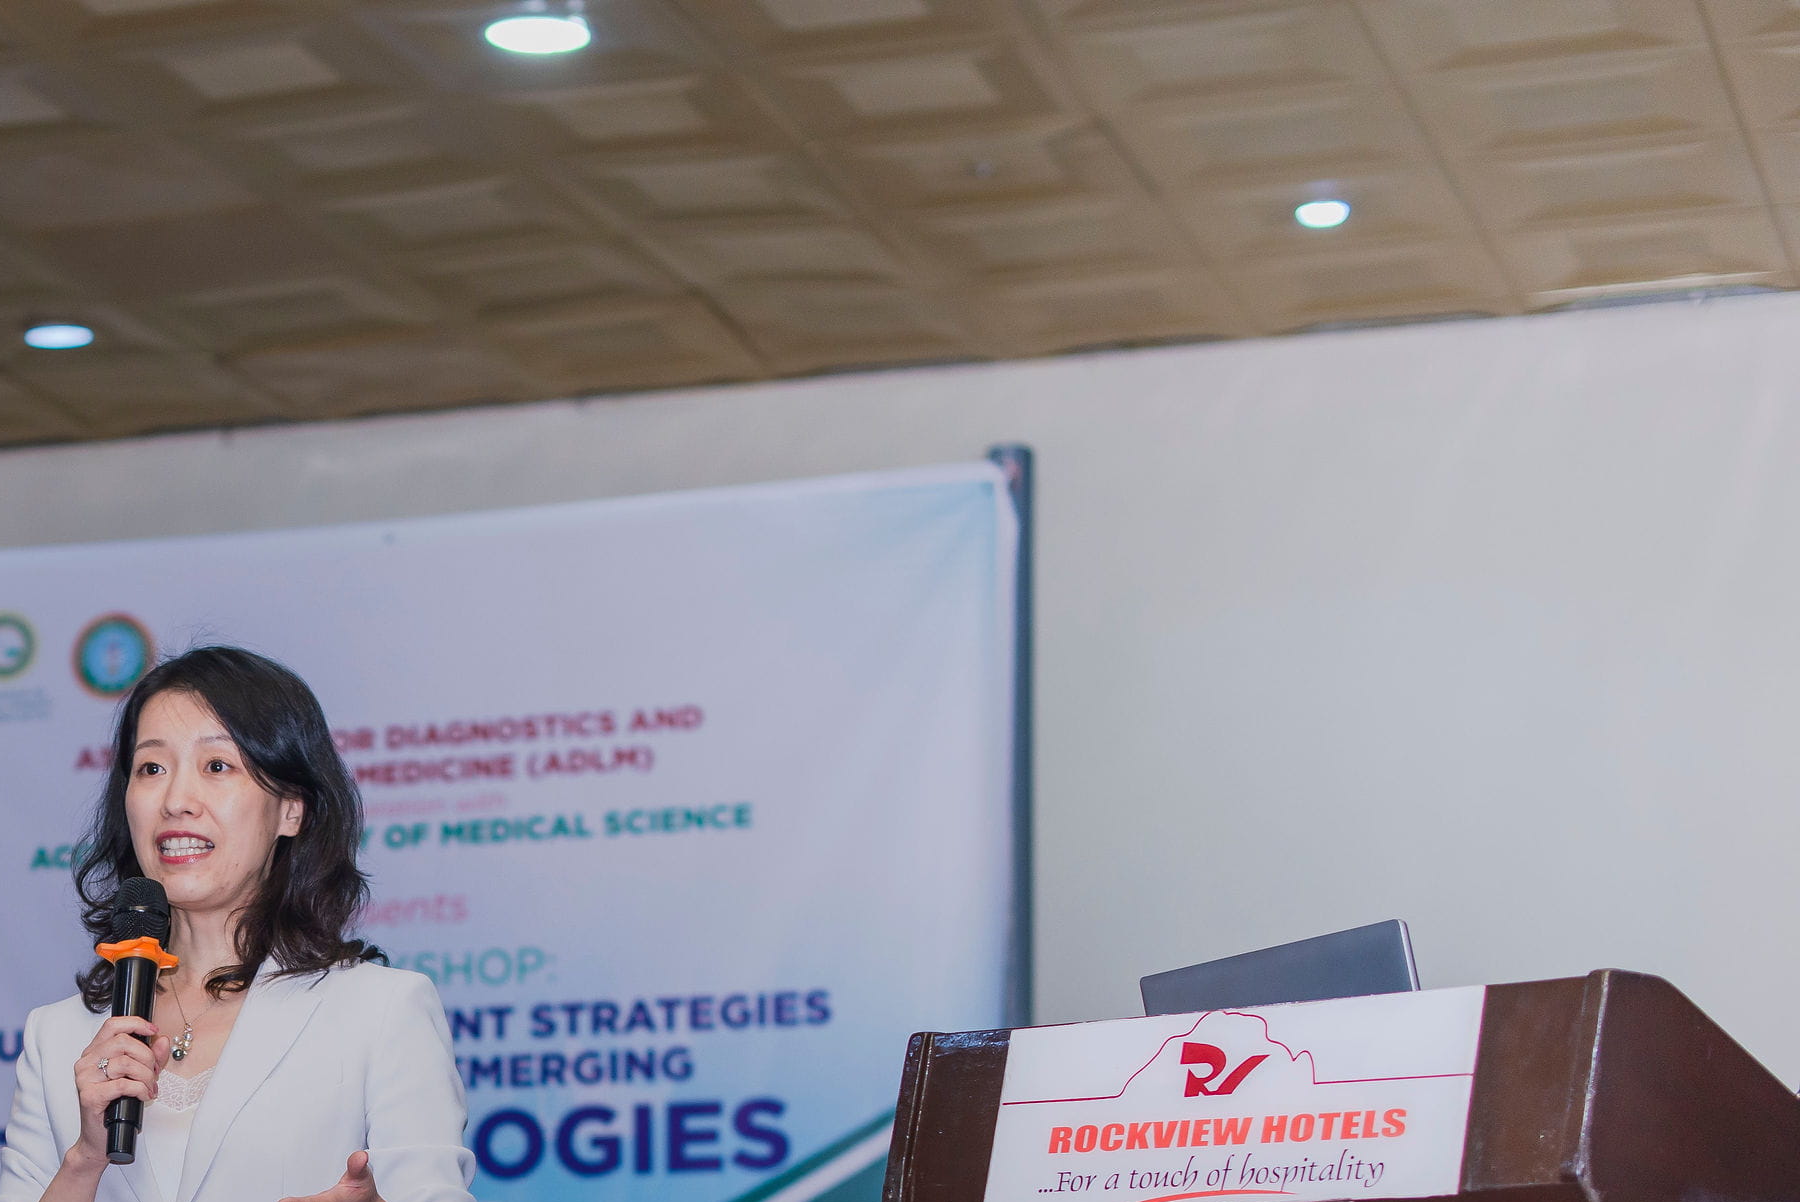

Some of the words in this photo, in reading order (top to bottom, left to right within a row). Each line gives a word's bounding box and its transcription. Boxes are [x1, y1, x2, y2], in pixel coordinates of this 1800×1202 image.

[333, 727, 374, 754] OR
[385, 711, 615, 750] DIAGNOSTICS
[629, 705, 704, 734] AND
[526, 745, 655, 779] (ADLM)
[384, 822, 428, 850] OF
[440, 812, 590, 846] MEDICAL
[604, 803, 754, 835] SCIENCE
[531, 990, 833, 1038] STRATEGIES
[458, 1047, 694, 1088] MERGING
[1048, 1116, 1253, 1154] ROCKVIEW
[1261, 1108, 1408, 1144] HOTELS
[1104, 1173, 1120, 1190] a
[1128, 1156, 1199, 1193] touch
[1205, 1153, 1235, 1192] of
[1239, 1149, 1384, 1192] hospitality
